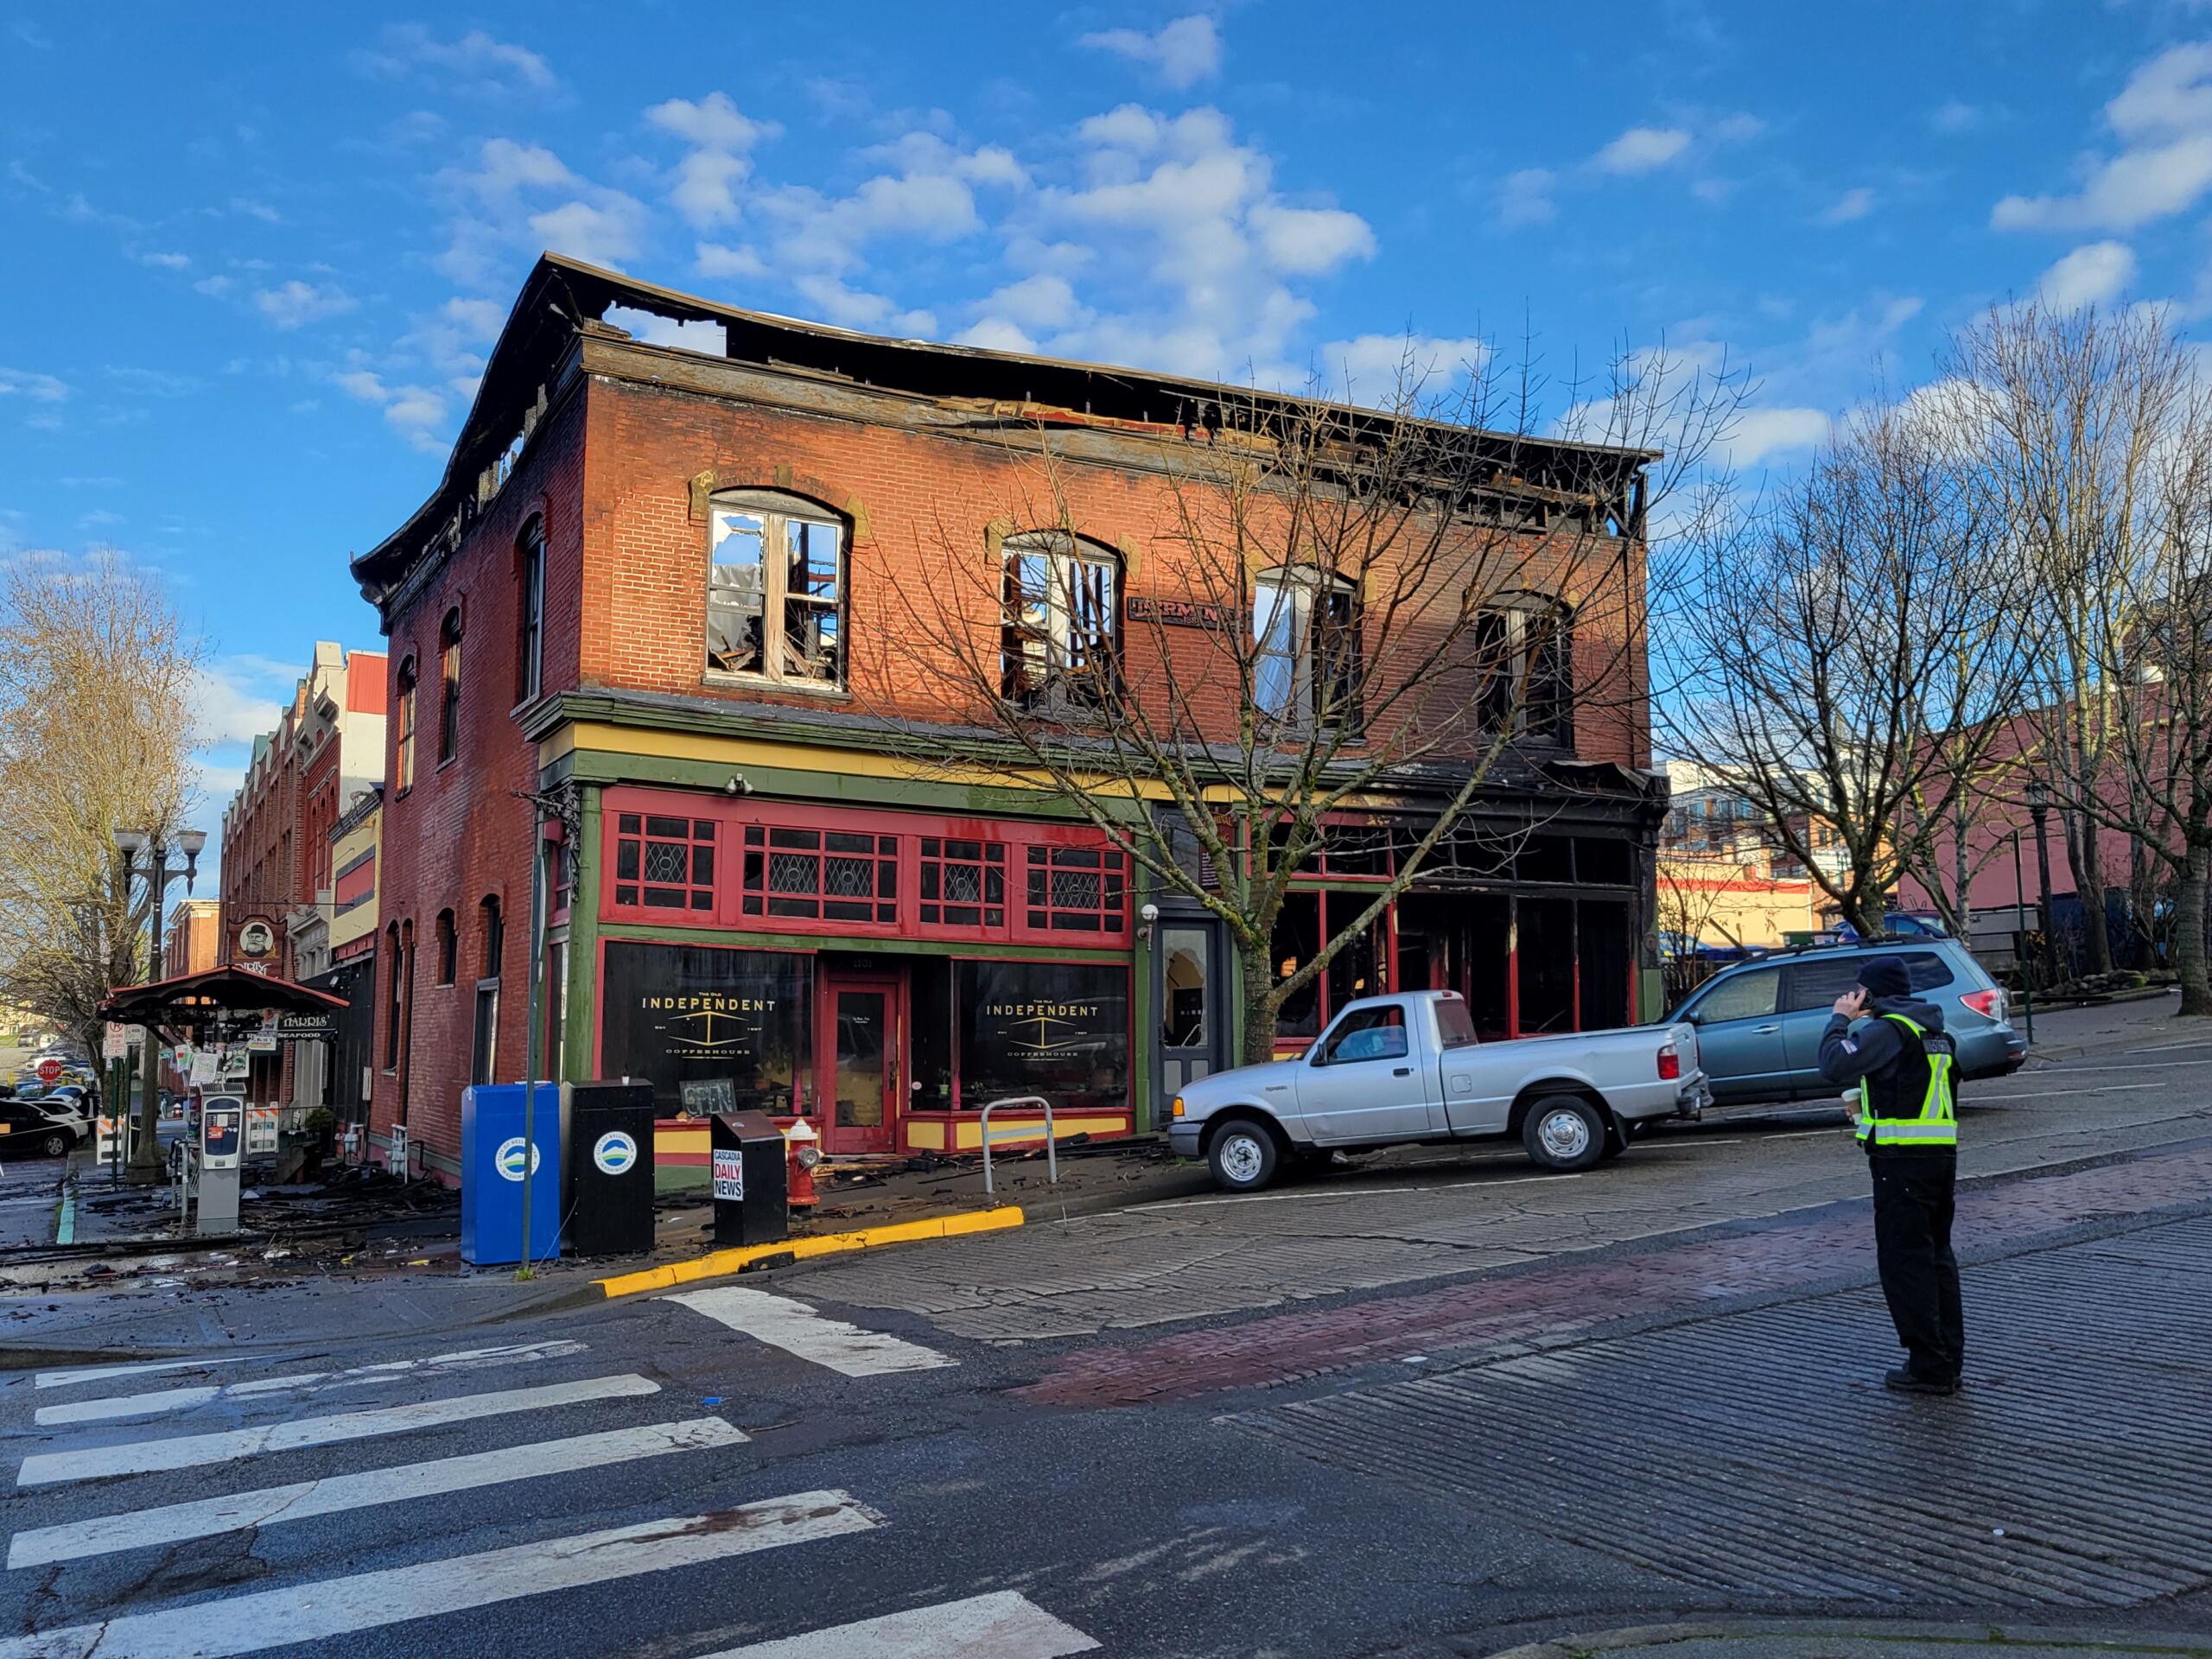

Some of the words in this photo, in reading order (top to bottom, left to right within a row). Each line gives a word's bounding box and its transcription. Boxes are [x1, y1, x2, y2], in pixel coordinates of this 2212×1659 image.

[642, 997, 775, 1011] INDEPENDENT
[987, 1005, 1097, 1016] INDEPENDENT
[40, 1065, 60, 1075] STOP
[715, 1150, 741, 1161] CASCADIA
[715, 1163, 741, 1180] DAILY
[715, 1179, 741, 1197] NEWS
